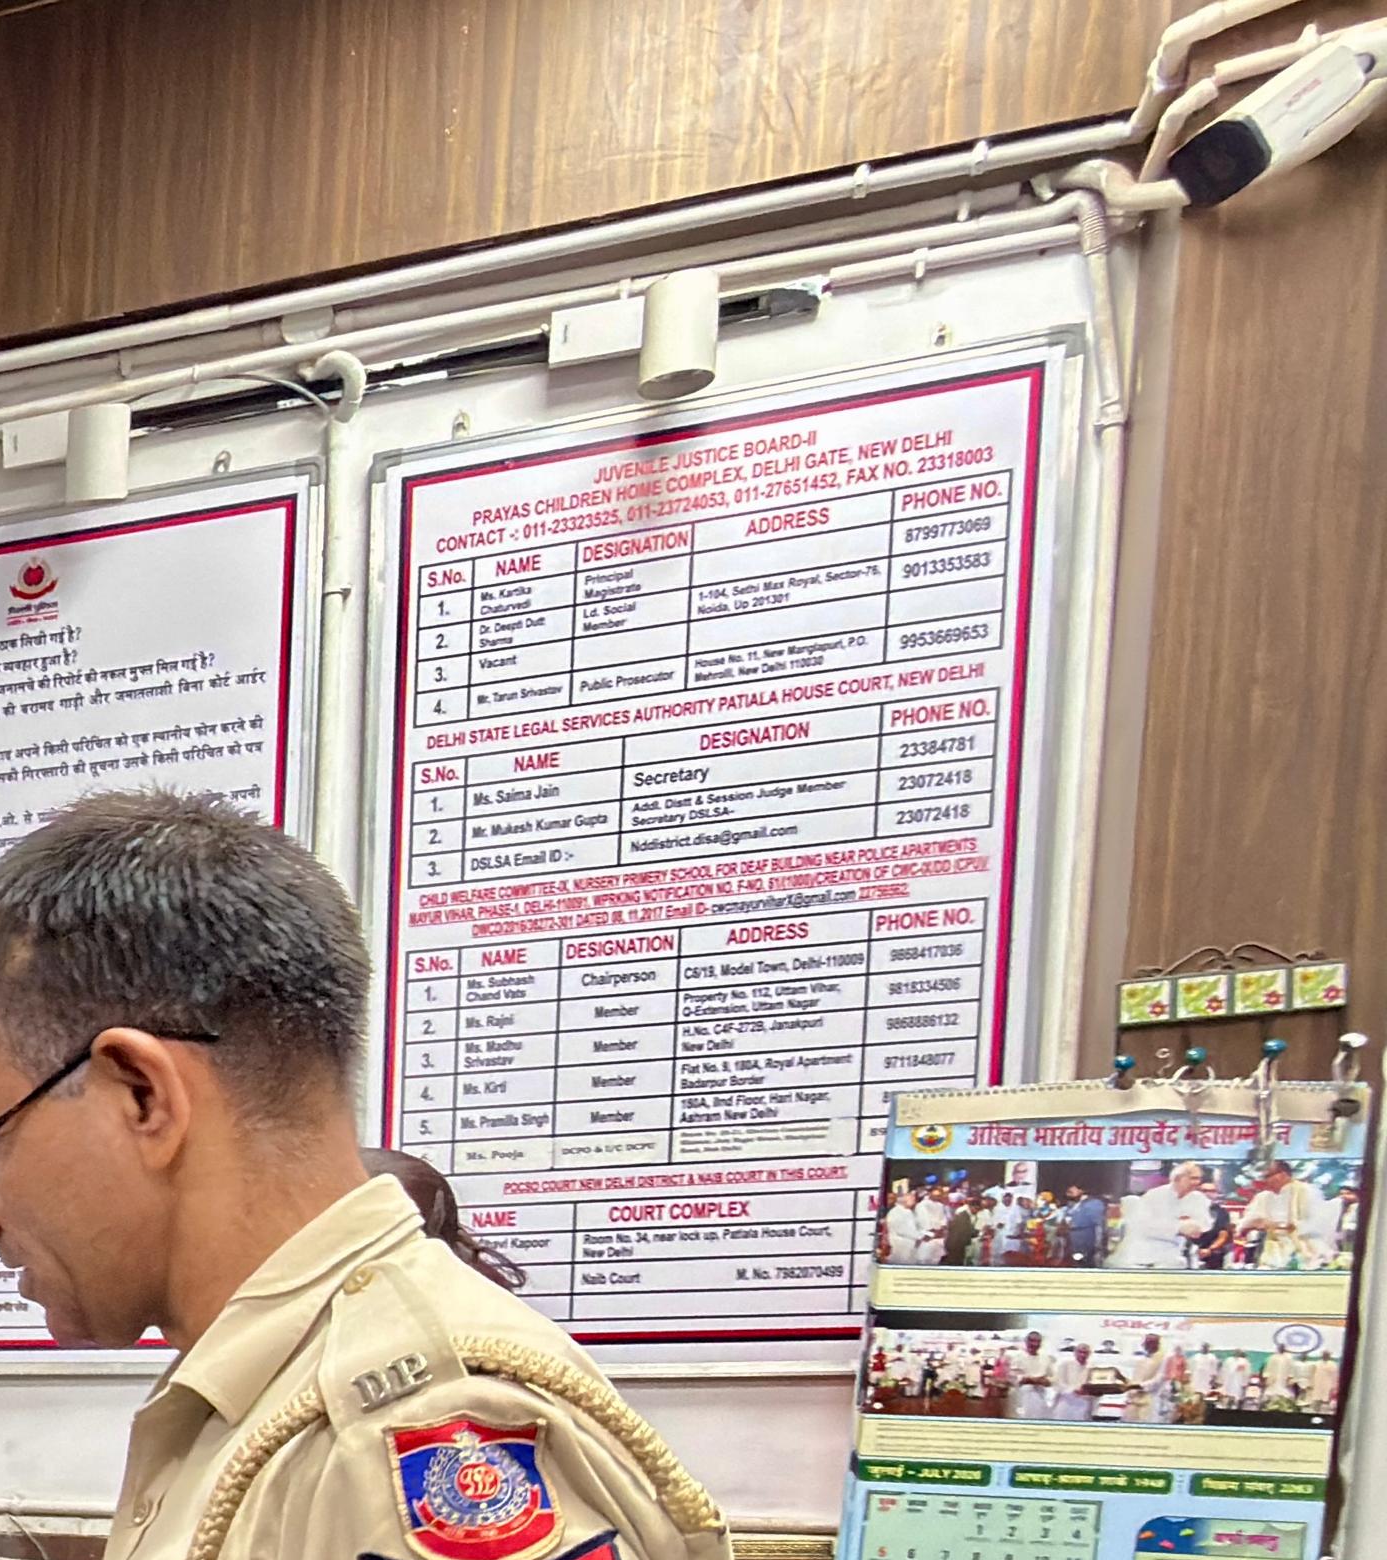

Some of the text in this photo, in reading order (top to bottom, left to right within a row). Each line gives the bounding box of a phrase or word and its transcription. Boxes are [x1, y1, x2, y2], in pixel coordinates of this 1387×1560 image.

[592, 428, 818, 486] JUVENILE JUSTICE BOARD-II
[471, 428, 953, 527] PRAYAS CHILDREN HOME COMPLEX, DELHI GATE, NEW DELHI
[435, 525, 507, 555] CONTACT
[521, 505, 624, 542] 011-23323525,
[625, 488, 731, 525] 011-23724053,
[732, 469, 842, 506] 011-27651452,
[845, 463, 880, 486] FAX
[882, 457, 914, 480] NO.
[916, 443, 995, 475] 23318003
[900, 477, 1003, 513] PHONE NO.
[744, 505, 831, 538] ADDRESS
[903, 514, 992, 544] 8799773069
[581, 528, 689, 564] DESIGNATION
[494, 552, 542, 578] NAME
[901, 549, 992, 580] 9013353583
[426, 565, 467, 589] S.No.
[583, 566, 634, 588] Principal
[583, 579, 642, 603] Magistrate
[436, 598, 451, 618] 1.
[602, 599, 637, 617] Social
[582, 615, 627, 633] Member
[434, 631, 449, 650] 2.
[433, 664, 448, 683] 3.
[477, 652, 517, 671] Vacant
[578, 666, 675, 693] Public Prosecutor
[425, 660, 985, 751] DELHI STATE LEGAL SERVICES AUTHORITY PATIALA HOUSE COURT, NEW DELHI
[432, 697, 447, 716] 4.
[889, 696, 991, 729] PHONE NO.
[699, 719, 810, 753] DESIGNATION
[897, 733, 976, 760] 23384781
[420, 762, 460, 786] S.No.
[513, 750, 560, 774] NAME
[632, 762, 710, 793] Secretary
[896, 766, 974, 793] 23072418
[429, 794, 444, 814] 1.
[472, 789, 494, 808] Ms.
[532, 781, 560, 800] Jain
[534, 814, 572, 833] Kumar
[572, 810, 609, 831] Gupta
[894, 801, 971, 827] 23072418
[427, 826, 443, 846] 2.
[426, 858, 442, 878] 3.
[469, 852, 513, 873] DSLSA
[512, 848, 547, 868] Email
[548, 847, 563, 864] ID
[874, 905, 976, 934] PHONE NO.
[725, 919, 809, 948] ADDRESS
[480, 946, 528, 969] NAME
[564, 931, 675, 962] DESIGNATION
[413, 952, 454, 975] S.No.
[580, 964, 657, 991] Chairperson
[423, 984, 438, 1003] 1.
[593, 1001, 640, 1020] Member
[421, 1017, 437, 1036] 2.
[592, 1036, 639, 1054] Member
[420, 1051, 436, 1070] 3.
[590, 1071, 637, 1090] Member
[419, 1084, 435, 1102] 4.
[418, 1117, 434, 1136] 5.
[589, 1107, 636, 1125] Member
[966, 1122, 1027, 1147] अखिल
[1033, 1121, 1104, 1147] भारतीय
[468, 1209, 517, 1233] NAME
[607, 1196, 750, 1224] COURT COMPLEX
[509, 1234, 552, 1252] Kapoor
[607, 1269, 641, 1286] Court
